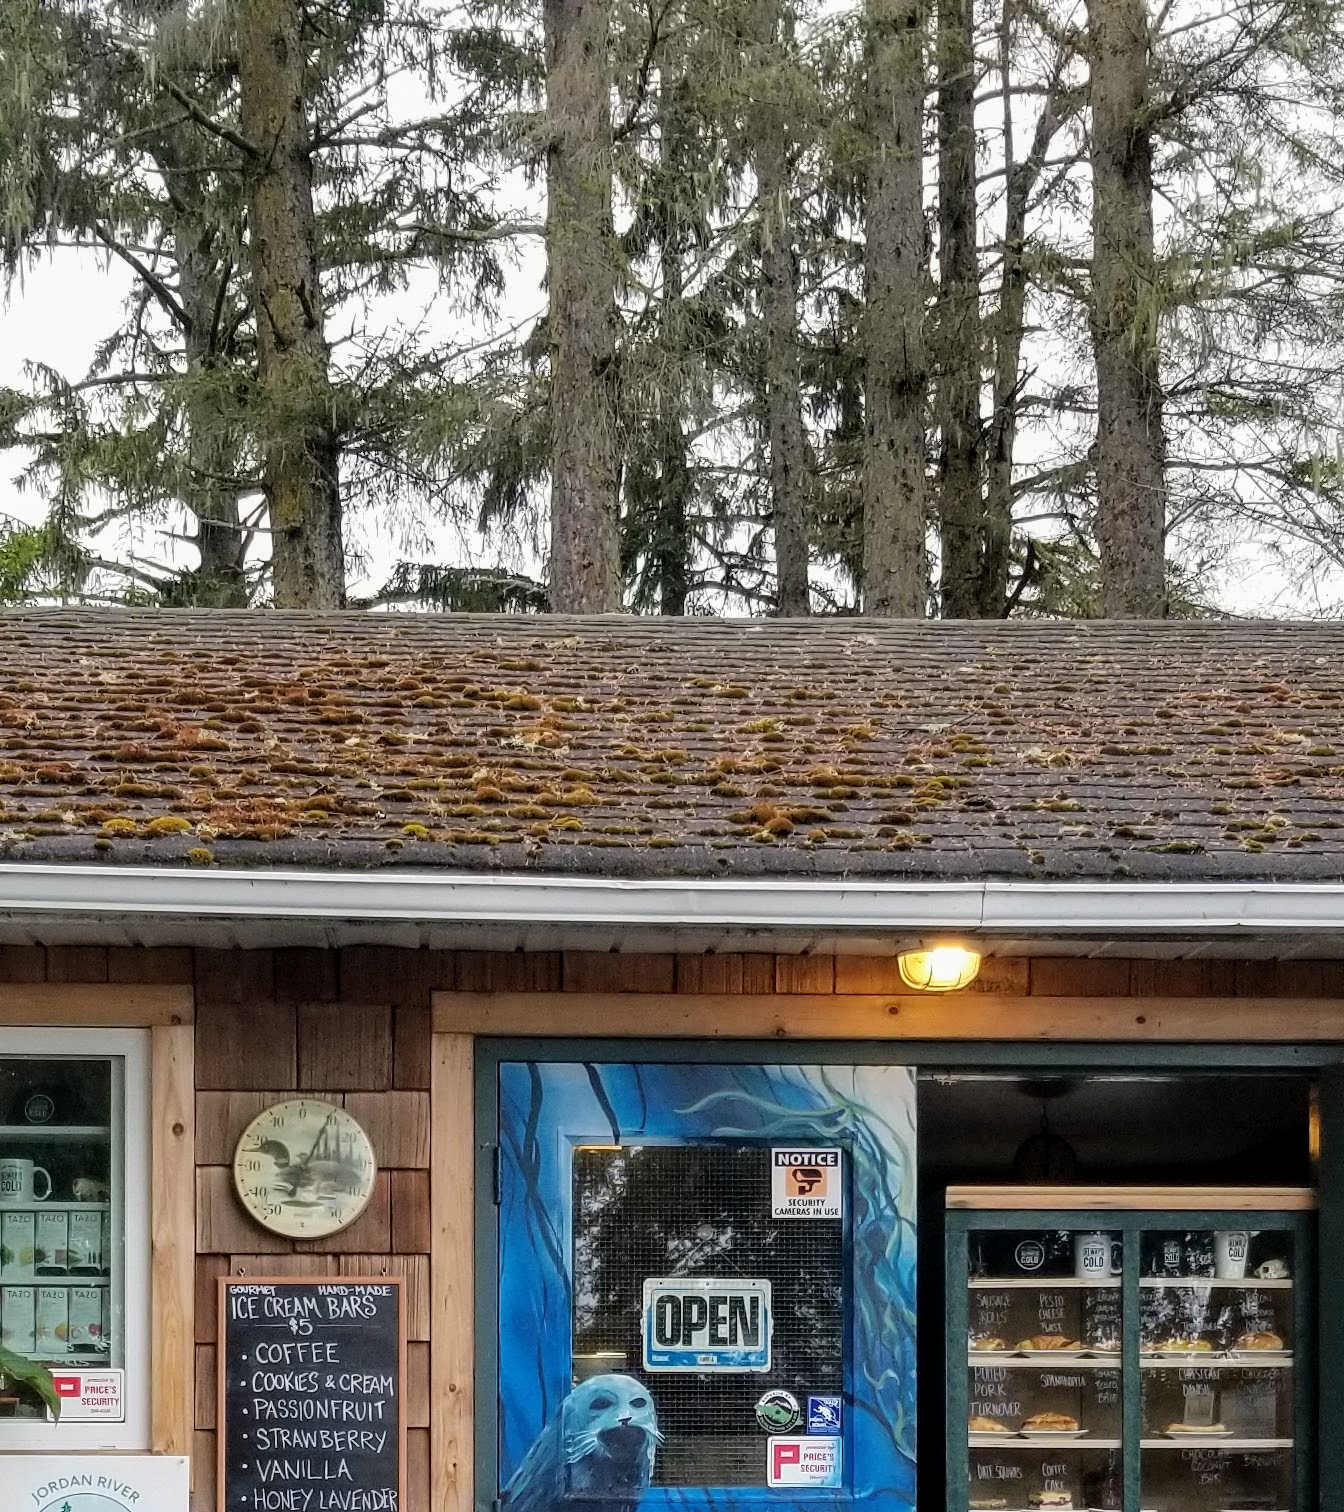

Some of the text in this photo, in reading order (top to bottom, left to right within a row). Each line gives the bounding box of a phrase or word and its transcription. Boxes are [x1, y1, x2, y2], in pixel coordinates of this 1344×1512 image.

[778, 1153, 836, 1166] NOTICE
[774, 1207, 839, 1216] CAMERAS IN USE
[788, 1199, 826, 1207] SECURITY
[1084, 1256, 1104, 1268] COLD
[230, 1285, 391, 1297] GOURMET HAND-MADE
[231, 1296, 376, 1320] ICE CREAM BARS
[289, 1317, 313, 1336] $5
[656, 1295, 759, 1347] OPEN
[256, 1343, 340, 1364] COFFEE
[84, 1385, 117, 1395] PRICE'S
[252, 1371, 394, 1397] COOKIES & CREAM
[81, 1397, 119, 1407] SECURITY
[253, 1399, 386, 1421] PASSIONFRUIT
[257, 1428, 387, 1453] STRAWBERRY
[804, 1453, 834, 1461] PRICE'S
[256, 1459, 353, 1482] VANILLA
[801, 1465, 836, 1473] SECURITY
[31, 1475, 140, 1505] JORDAN RIVER
[254, 1488, 397, 1512] HONEY LAVENDER
